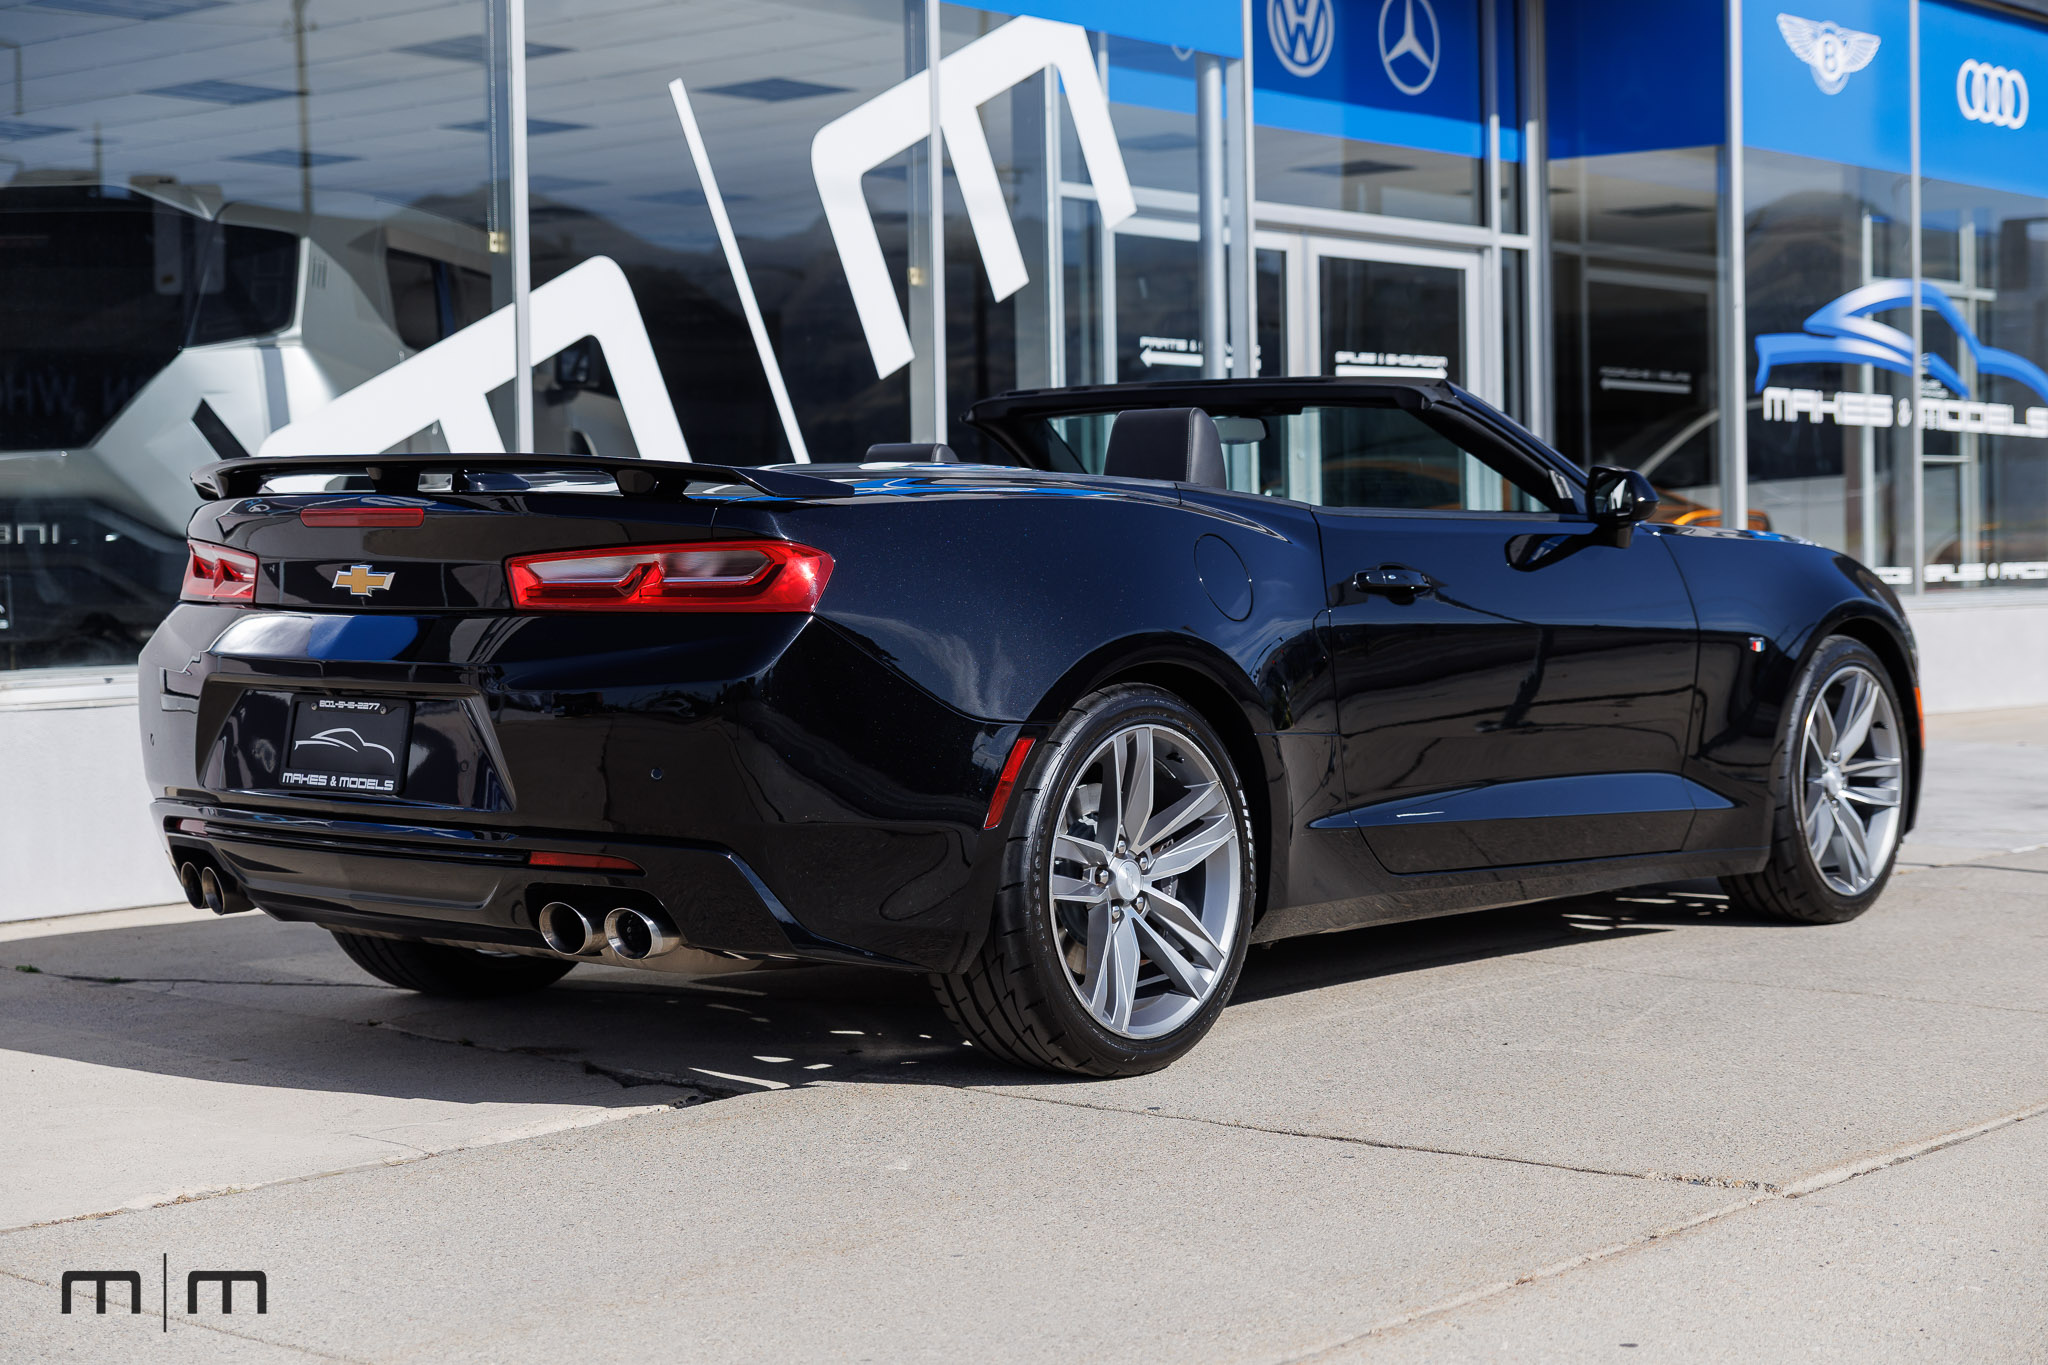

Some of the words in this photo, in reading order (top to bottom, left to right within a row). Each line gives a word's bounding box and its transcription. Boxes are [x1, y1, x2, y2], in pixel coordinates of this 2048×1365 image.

[1763, 387, 1893, 427] MAKES
[1897, 398, 1912, 427] &
[282, 772, 327, 786] MAKES
[330, 775, 337, 787] &
[339, 776, 394, 791] MODELS
